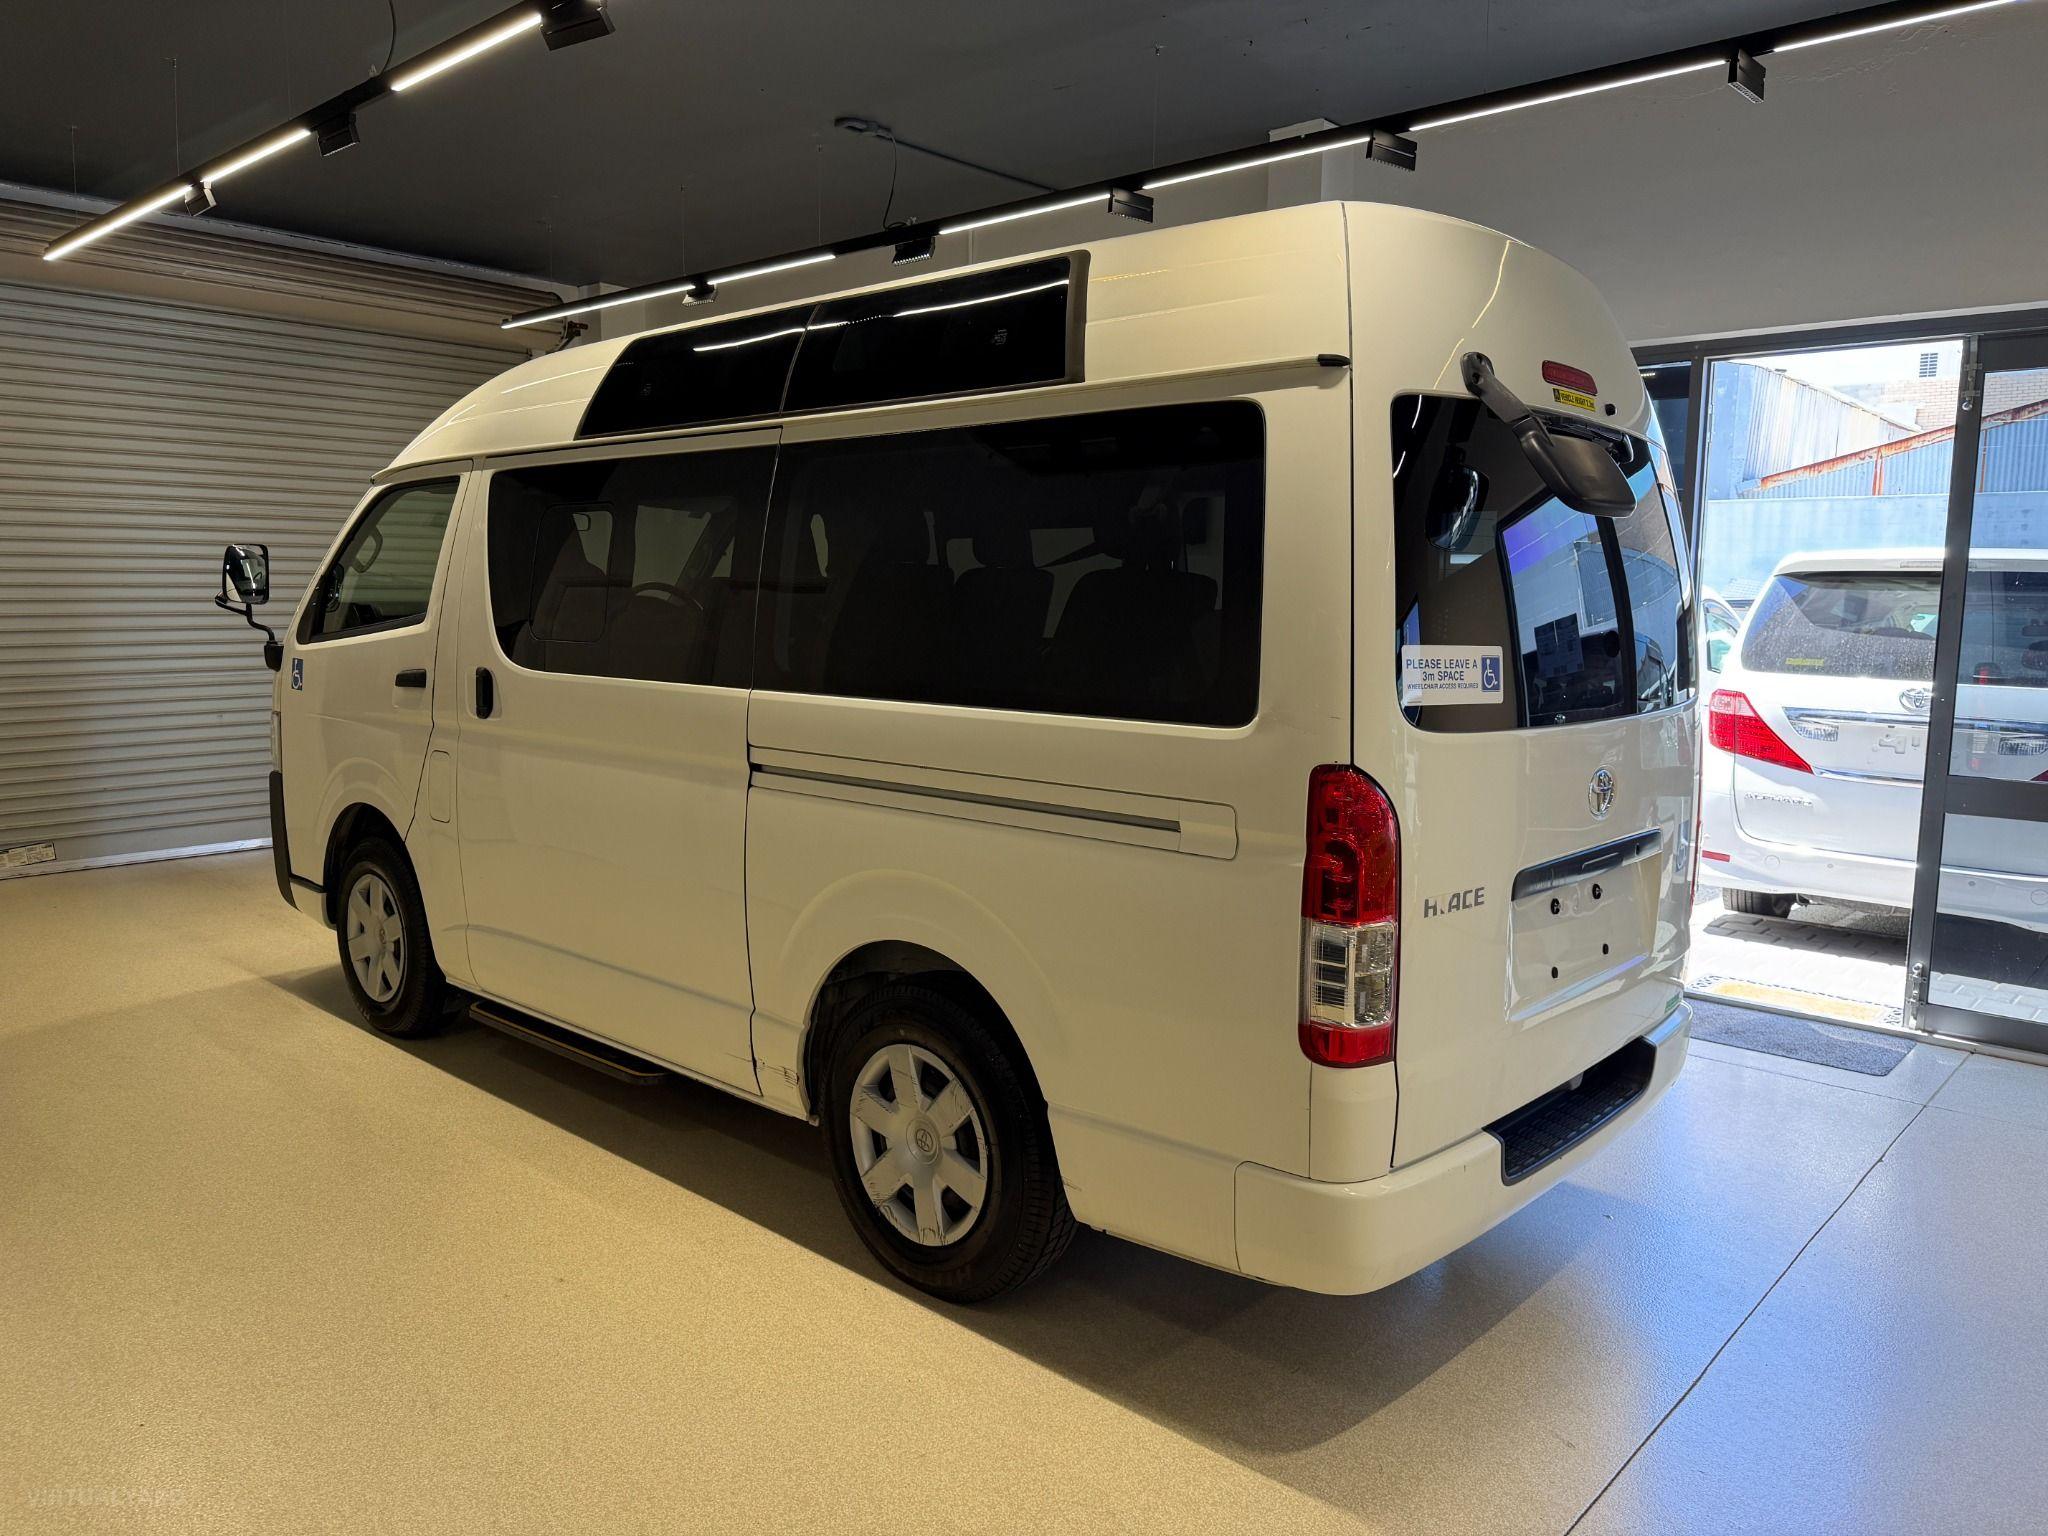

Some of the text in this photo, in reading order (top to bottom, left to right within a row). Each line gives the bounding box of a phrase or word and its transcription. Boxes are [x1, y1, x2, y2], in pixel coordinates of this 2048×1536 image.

[1406, 659, 1478, 669] PLEASE LEAVE A
[1422, 671, 1465, 681] 3m SPACE
[1423, 886, 1485, 918] HACE
